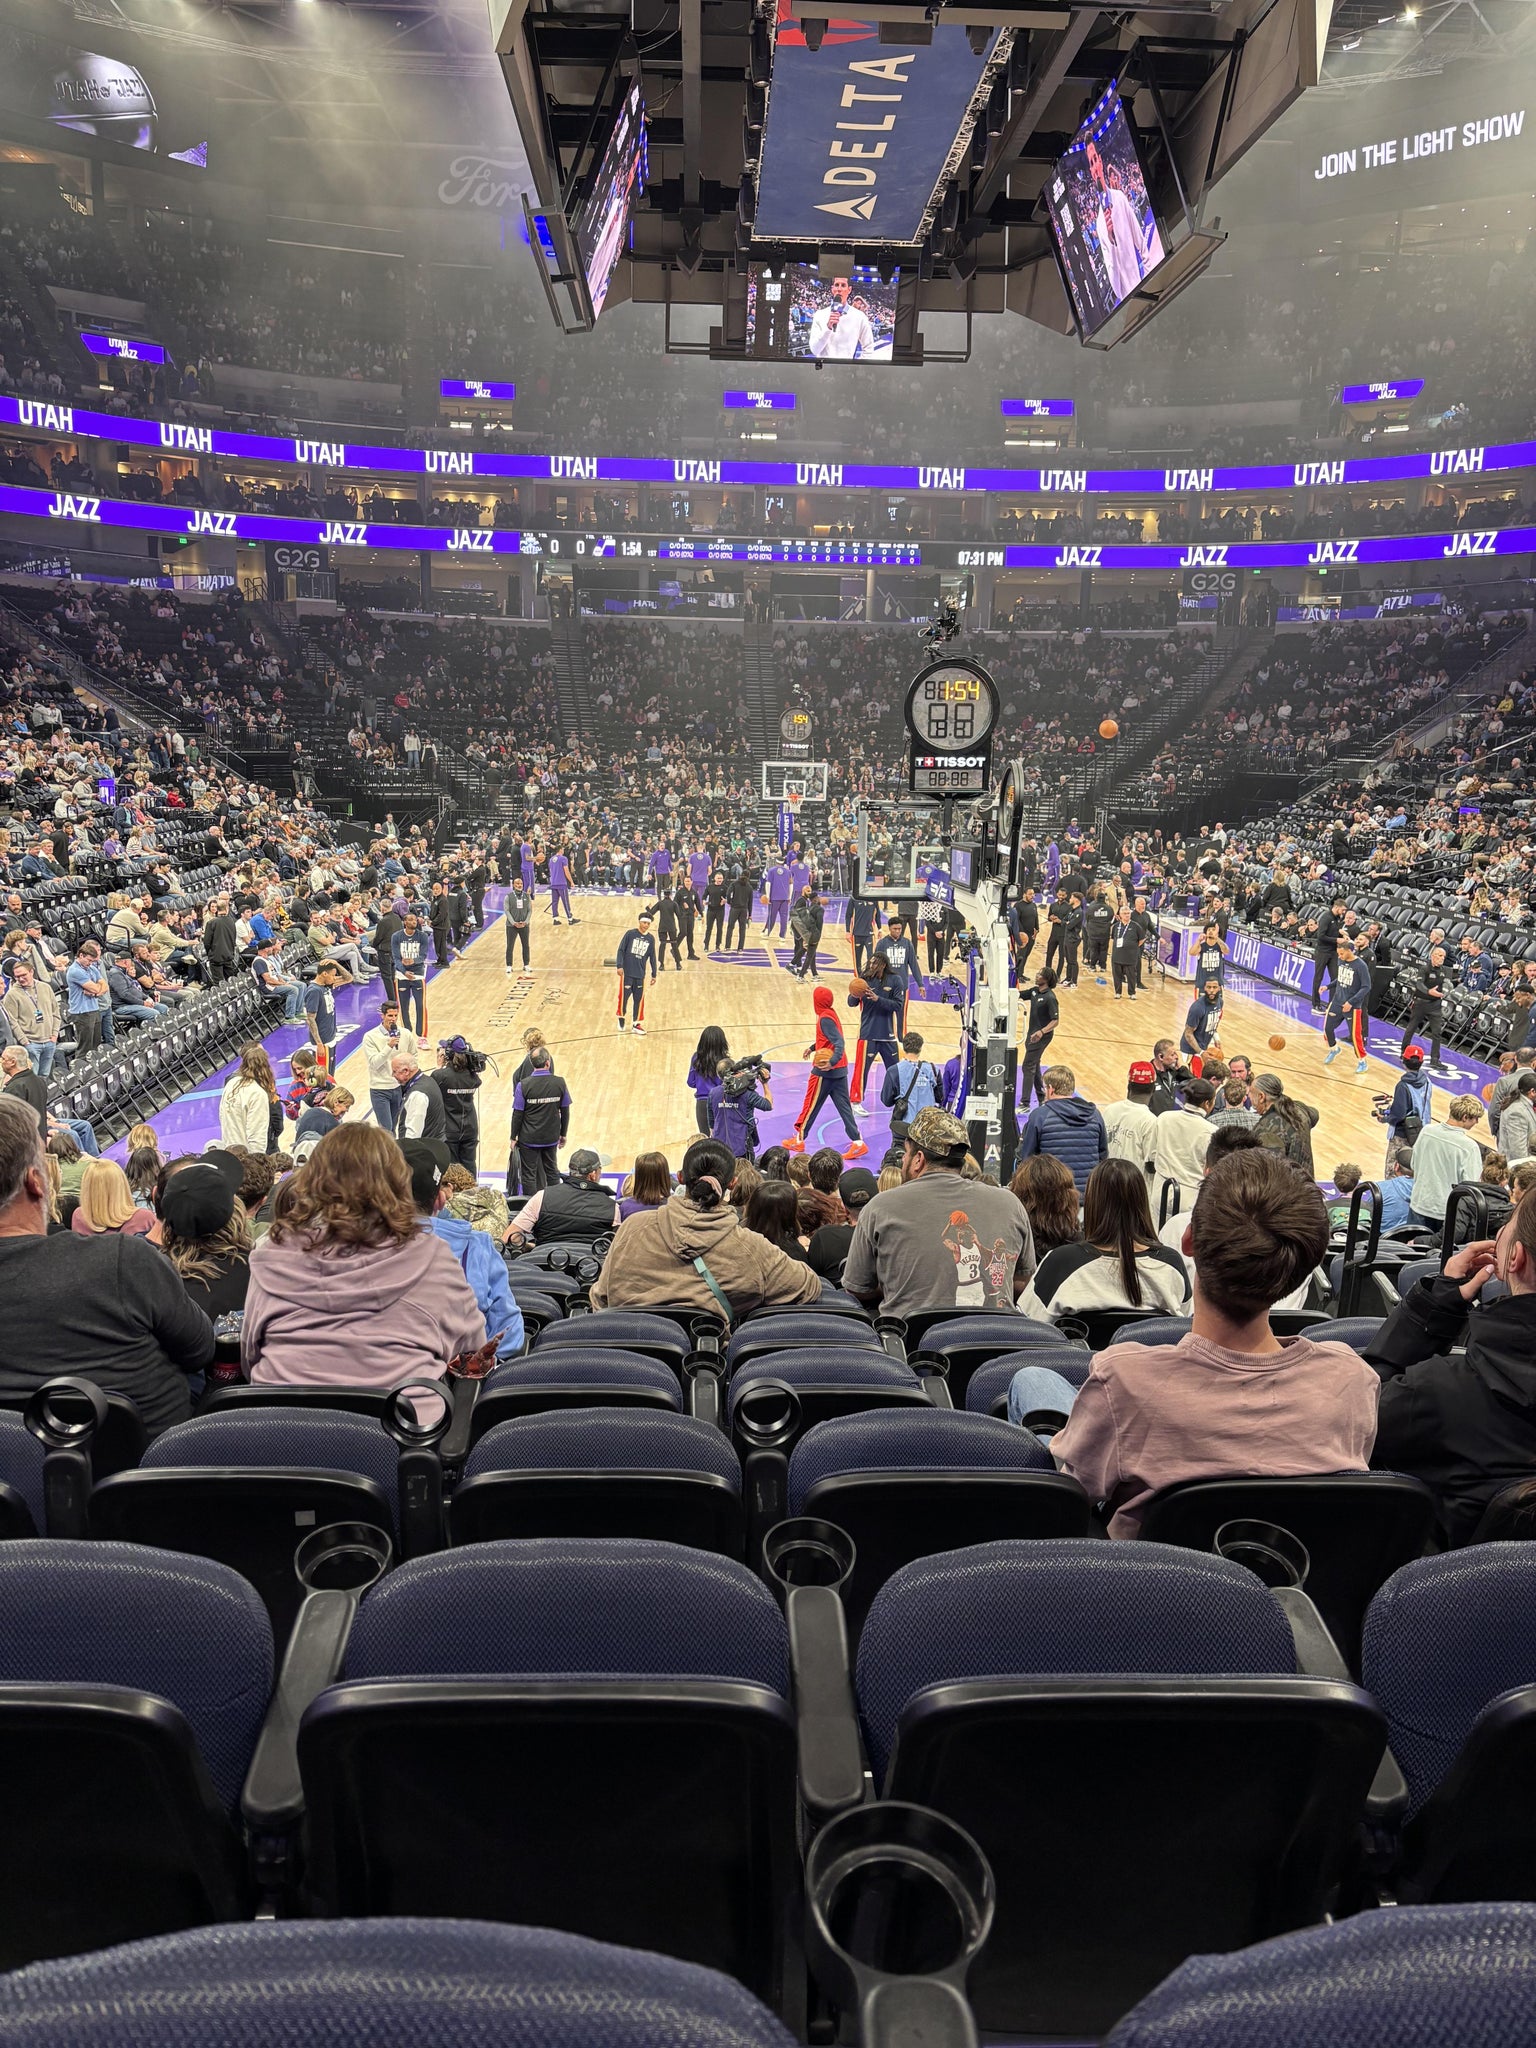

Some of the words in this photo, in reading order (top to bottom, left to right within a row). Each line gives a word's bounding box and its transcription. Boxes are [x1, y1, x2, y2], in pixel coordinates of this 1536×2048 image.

[823, 54, 915, 186] DELTA
[1314, 149, 1356, 180] JOIN
[1362, 140, 1397, 168] THE
[1403, 126, 1457, 160] LIGHT
[1462, 110, 1525, 147] SHOW
[109, 338, 128, 350] UTAH
[118, 348, 138, 360] JAZZ
[465, 381, 482, 390] UTAH
[474, 389, 491, 398] JAZZ
[747, 392, 765, 400] UTAH
[1369, 383, 1389, 393] UTAH
[1378, 390, 1396, 400] JAZZ
[755, 400, 772, 408] JAZZ
[1025, 399, 1042, 408] UTAH
[1033, 407, 1050, 415] JAZZ
[19, 399, 73, 431] UTAH
[161, 423, 212, 452] UTAH
[295, 440, 345, 466] UTAH
[425, 450, 473, 474] UTAH
[1430, 447, 1484, 475] UTAH
[551, 456, 597, 478] UTAH
[675, 460, 721, 482] UTAH
[796, 463, 843, 485] UTAH
[918, 467, 965, 488] UTAH
[1294, 461, 1345, 485] UTAH
[1040, 470, 1086, 491] UTAH
[1165, 468, 1214, 491] UTAH
[49, 494, 100, 521] JAZZ
[187, 511, 237, 536] JAZZ
[319, 524, 367, 545] JAZZ
[447, 529, 494, 551] JAZZ
[1443, 531, 1497, 557] JAZZ
[551, 540, 559, 553] 0
[576, 540, 585, 554] 0
[621, 541, 642, 556] 1:54
[1056, 546, 1102, 566] JAZZ
[1180, 545, 1228, 566] JAZZ
[1308, 540, 1359, 563] JAZZ
[274, 547, 320, 568] G2G
[958, 551, 985, 565] 07:31
[987, 551, 1004, 566] PM
[1191, 572, 1236, 590] G2G
[944, 681, 980, 700] 1:54
[935, 757, 986, 767] TISSOT
[1233, 935, 1260, 970] UTAH
[1274, 951, 1306, 989] JAZZ
[969, 1263, 978, 1279] 3
[991, 1272, 1004, 1286] 23
